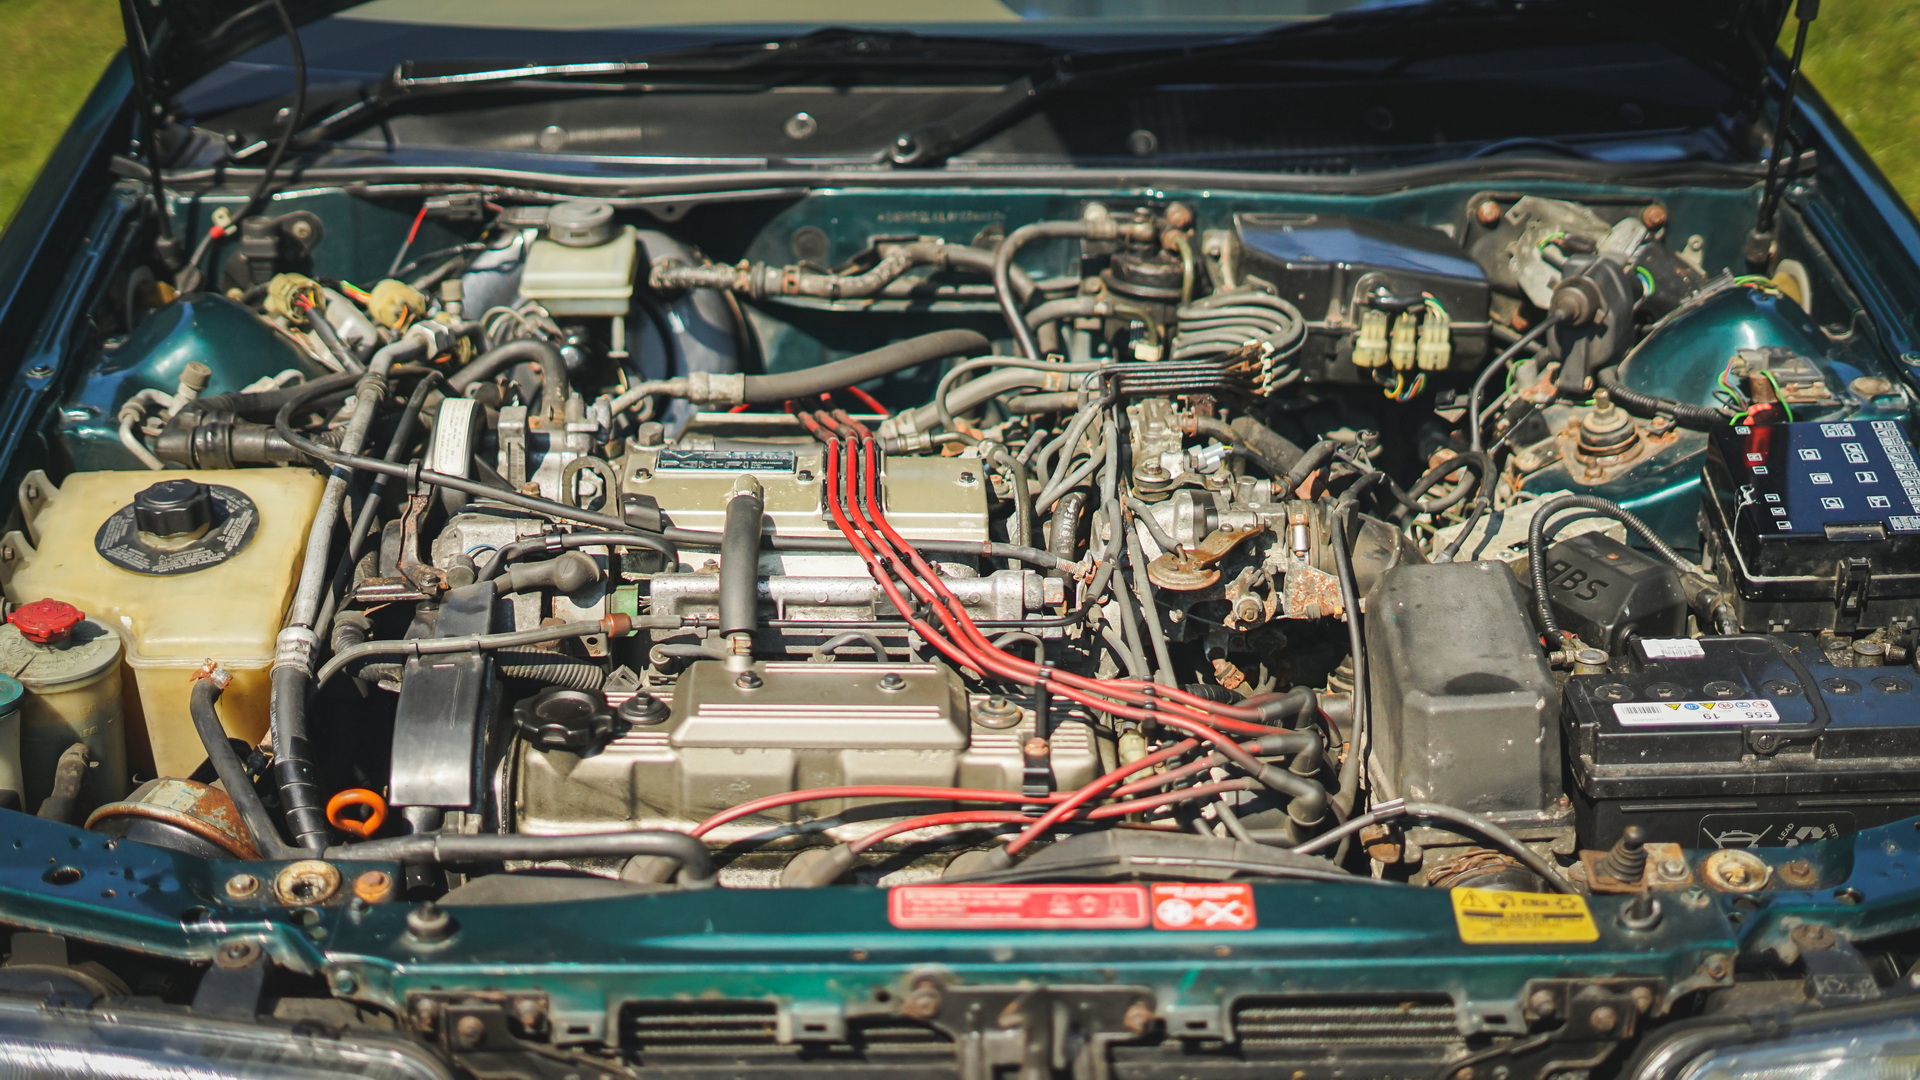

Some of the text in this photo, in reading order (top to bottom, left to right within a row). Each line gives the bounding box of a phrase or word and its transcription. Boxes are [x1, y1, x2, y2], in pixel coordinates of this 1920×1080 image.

[1546, 560, 1609, 601] ABS
[1745, 711, 1772, 719] 555
[1777, 823, 1794, 840] LEAD
